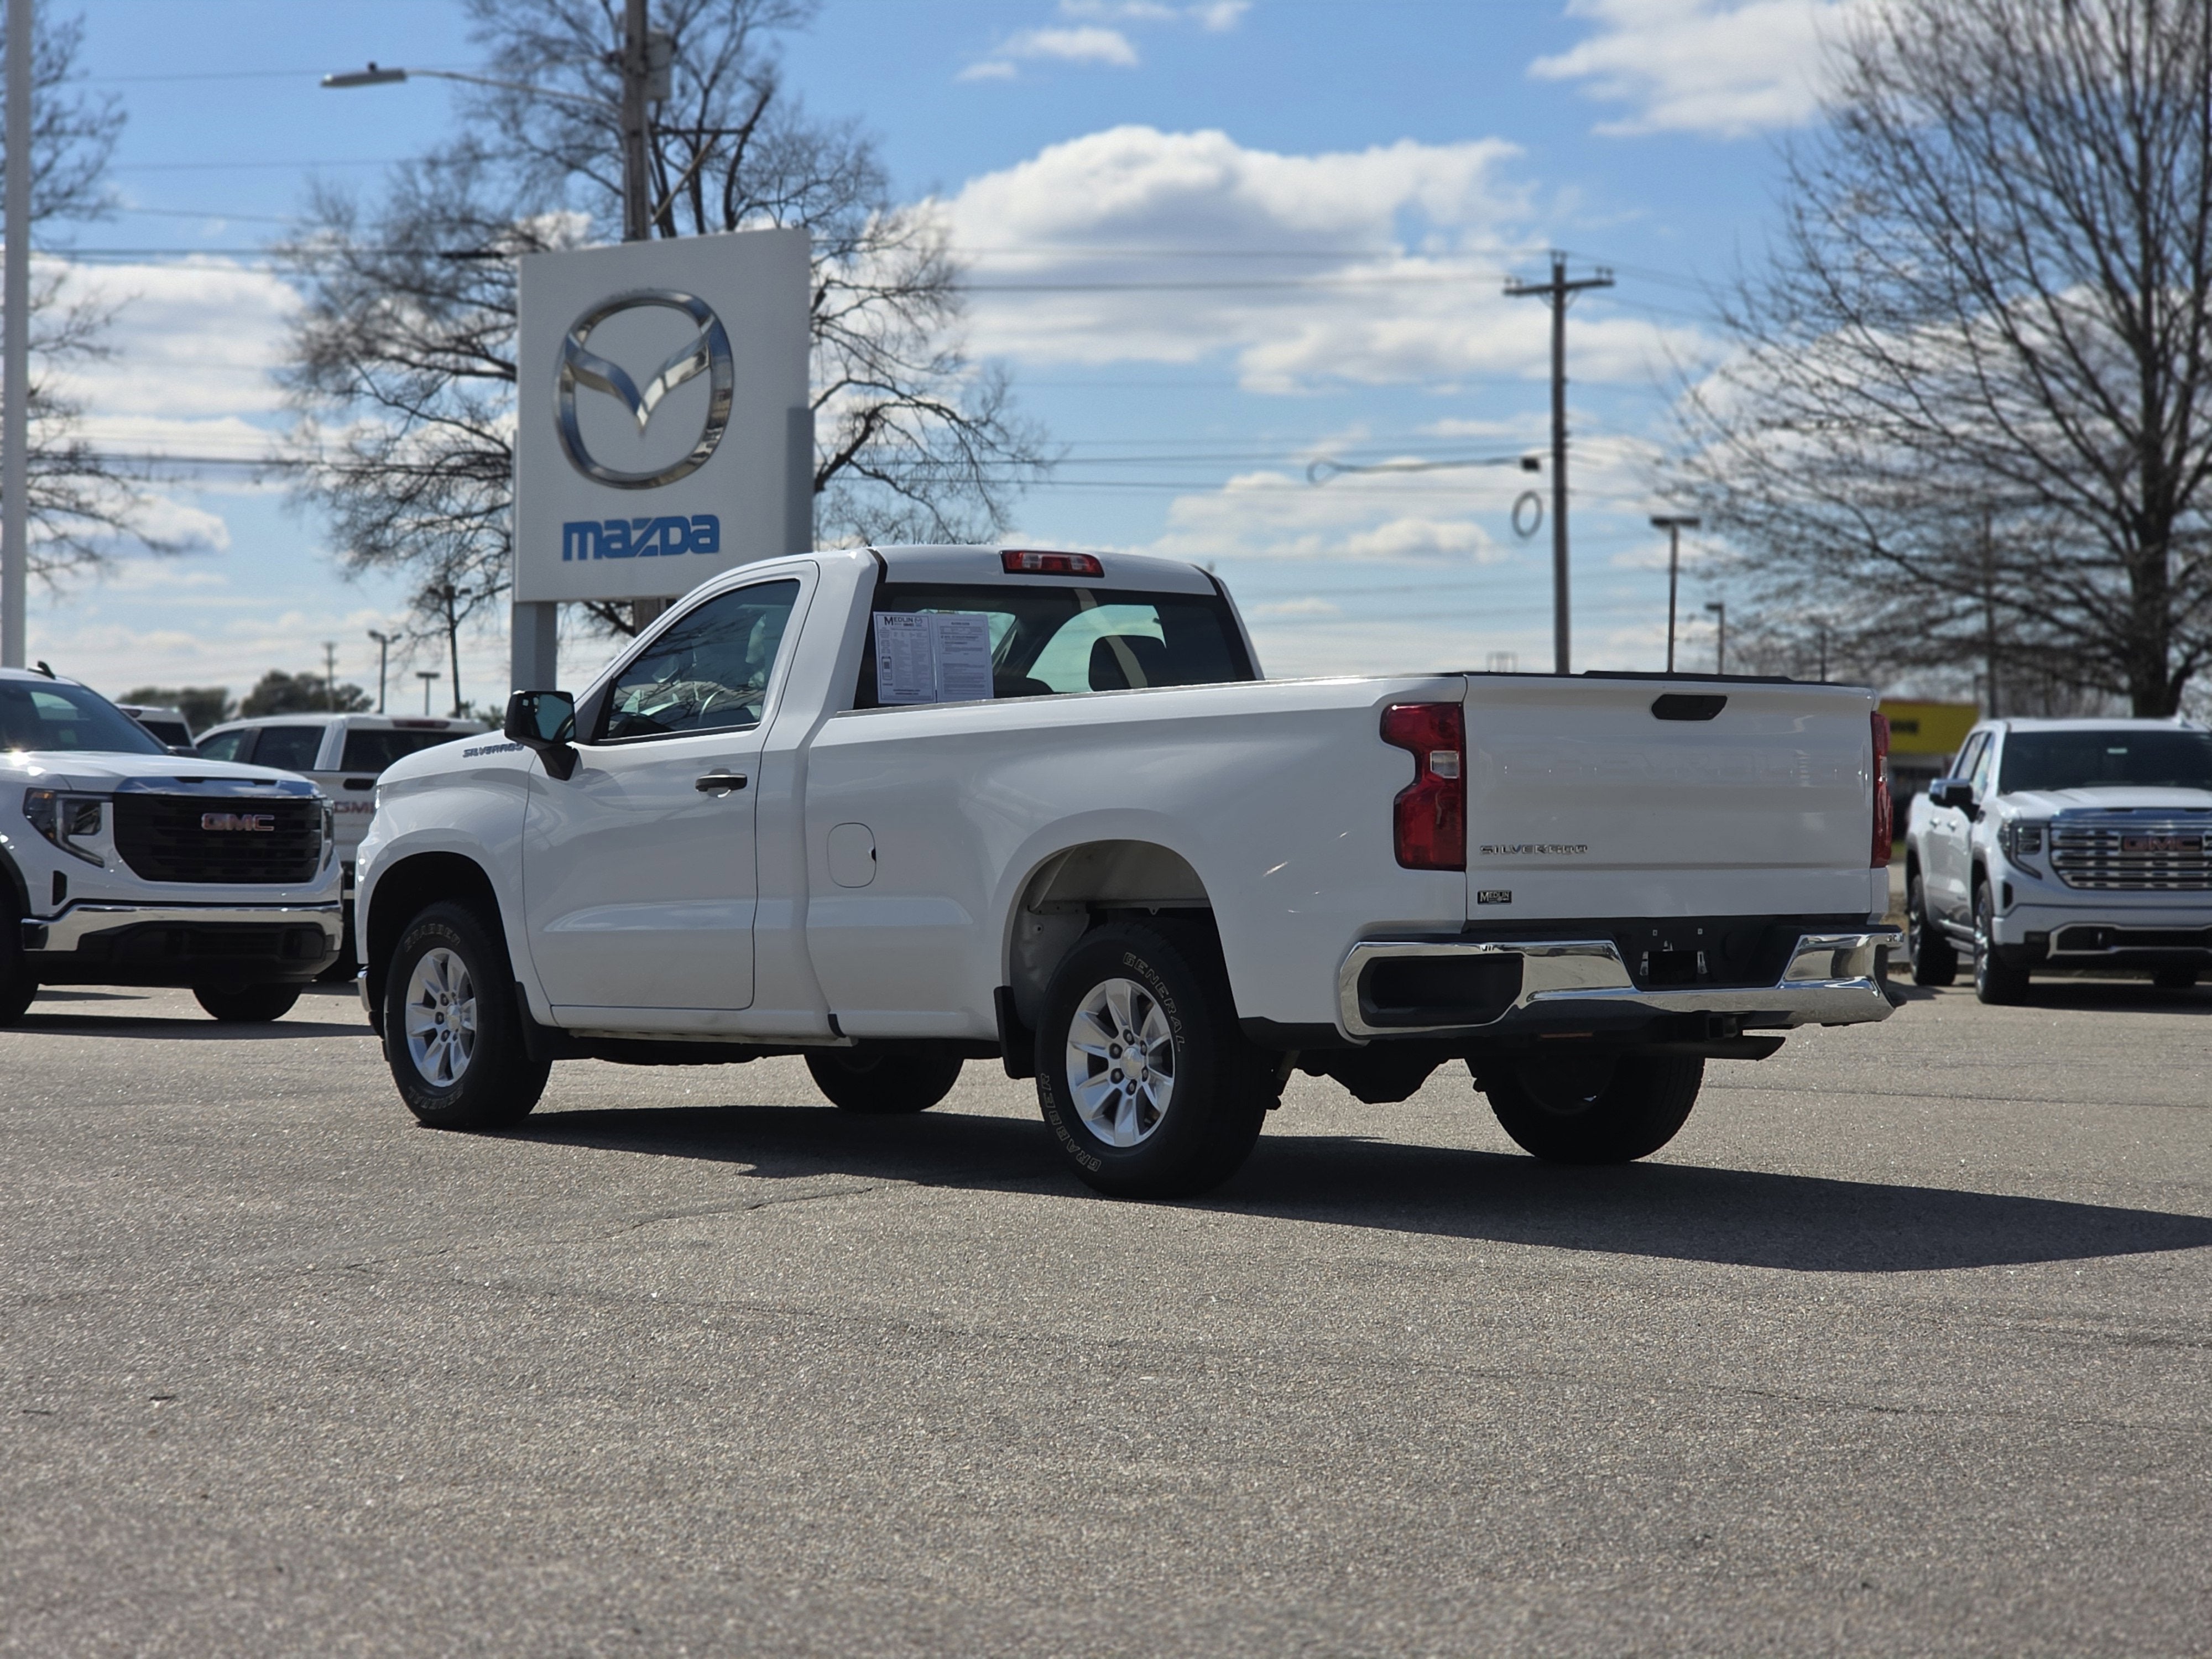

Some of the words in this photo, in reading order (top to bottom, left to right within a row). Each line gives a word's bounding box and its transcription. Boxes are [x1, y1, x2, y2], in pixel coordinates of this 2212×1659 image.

[884, 617, 914, 625] MEDLIN
[201, 813, 275, 831] GMC
[1480, 844, 1588, 854] SILVERADO
[2124, 835, 2201, 852] GMC
[1123, 952, 1185, 1052] GENERAL
[1040, 1073, 1102, 1172] GRABBER
